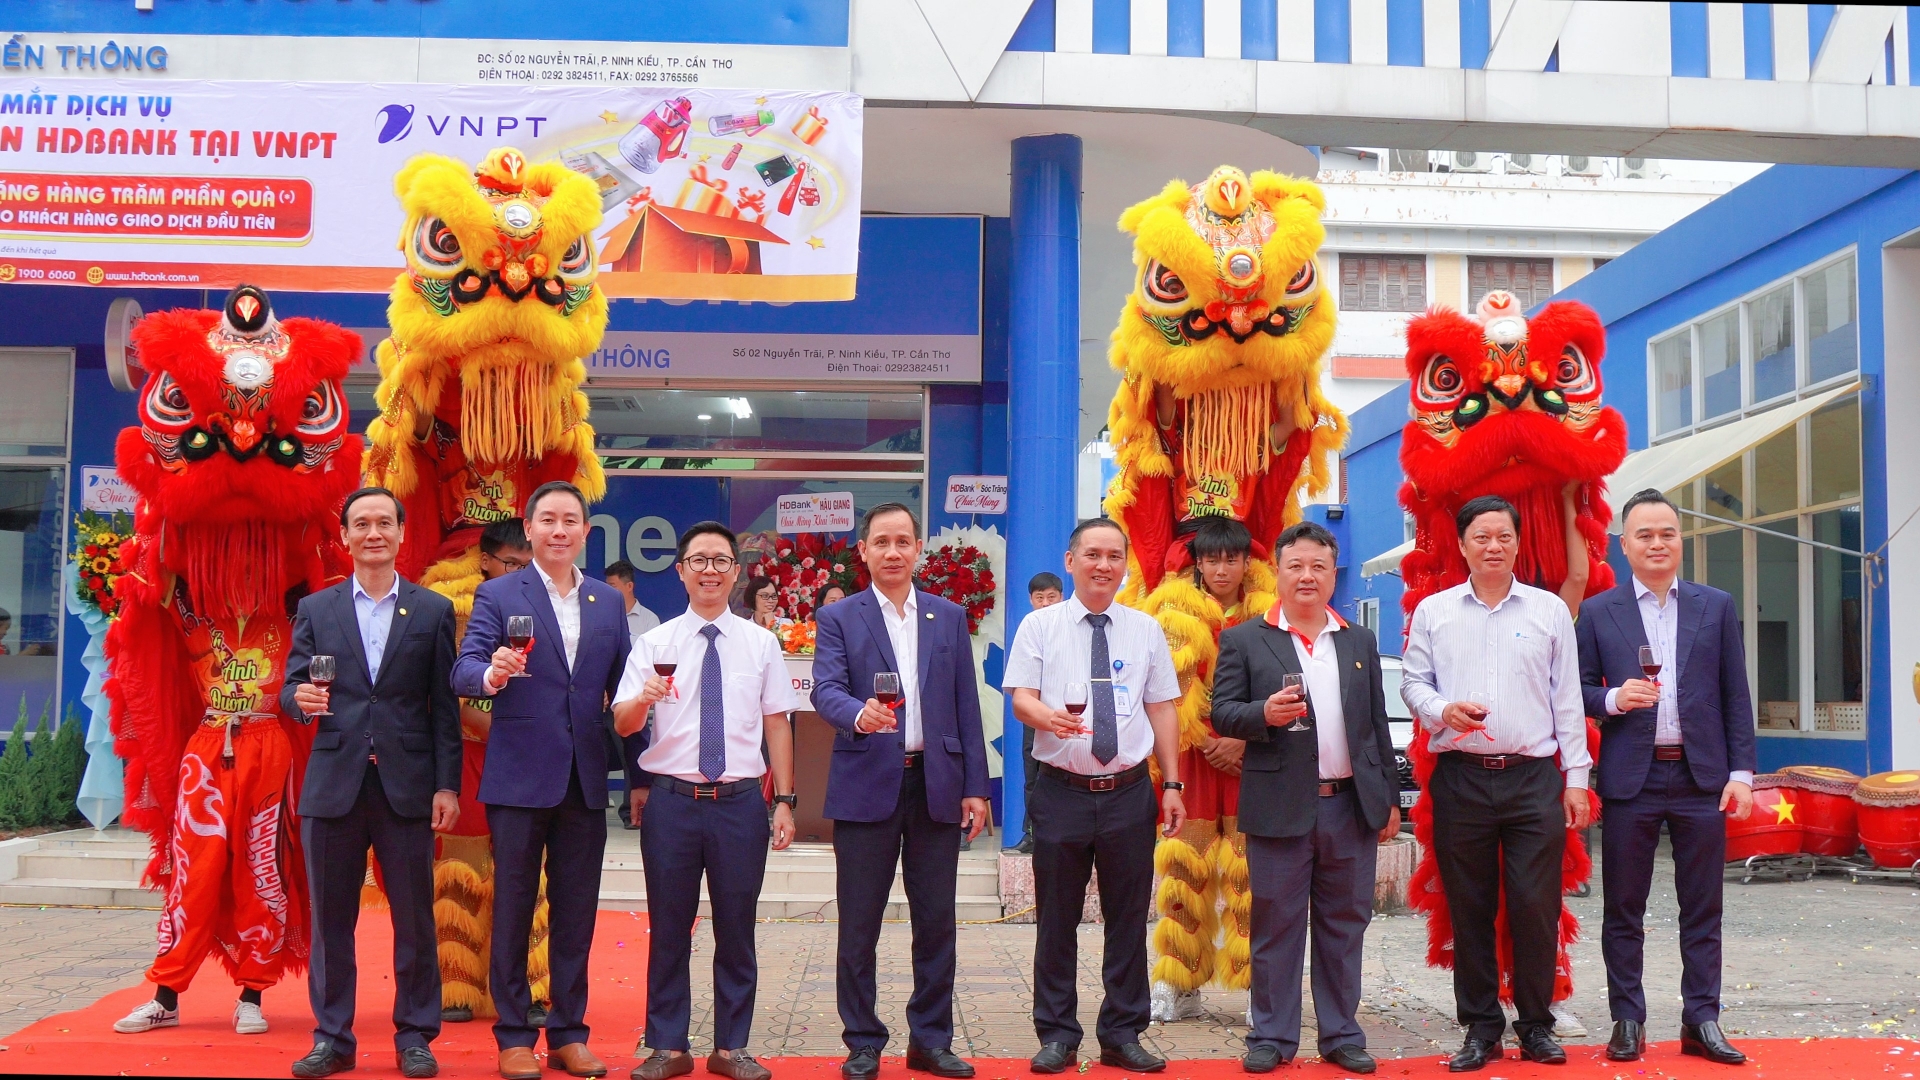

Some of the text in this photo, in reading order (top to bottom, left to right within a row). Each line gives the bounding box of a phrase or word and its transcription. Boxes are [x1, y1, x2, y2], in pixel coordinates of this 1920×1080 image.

[56, 40, 168, 71] THÔNG
[477, 53, 495, 64] ĐC:
[498, 49, 512, 64] SỐ
[514, 54, 526, 64] 02
[528, 50, 571, 65] NGUYỄN
[611, 56, 634, 67] NINH
[667, 57, 683, 68] TP.
[712, 58, 733, 70] THƠ
[478, 66, 502, 81] ĐIỆN
[541, 70, 563, 81] 0292
[609, 71, 633, 82] FAX:
[635, 71, 657, 82] 0292
[660, 72, 699, 83] 3765566
[1, 86, 172, 123] MẮT DỊCH VỤ
[427, 114, 547, 138] VNPT
[36, 127, 178, 156] HDBANK
[190, 129, 240, 164] TẠI
[252, 130, 338, 159] VNPT
[46, 181, 106, 205] HÀNG
[111, 183, 166, 206] TRĂM
[171, 182, 226, 206] PHẦN
[231, 185, 276, 209] QUÀ
[18, 208, 69, 226] KHÁCH
[73, 209, 119, 227] HÀNG
[122, 213, 164, 228] GIAO
[168, 214, 203, 231] DỊCH
[207, 211, 239, 229] ĐẦU
[243, 213, 276, 230] TIÊN
[16, 246, 28, 254] khi
[42, 247, 57, 256] quà
[18, 268, 200, 283] 1900 6060 www.hdbank.com.vn
[732, 347, 746, 358] Số
[748, 348, 761, 358] 02
[763, 347, 801, 360] Nguyễn
[803, 349, 825, 360] Trãi,
[827, 349, 836, 358] P.
[839, 349, 861, 359] Ninh
[891, 350, 907, 359] TP.
[932, 350, 951, 359] Thơ
[827, 363, 950, 374] Điện Thoại: 02923824511
[96, 487, 127, 505] Chúc
[950, 483, 976, 493] HDBank
[980, 484, 991, 493] Sóc
[779, 500, 812, 510] HDBank
[833, 499, 851, 511] GIANG
[954, 494, 976, 509] Chúc
[223, 658, 258, 683] Anh
